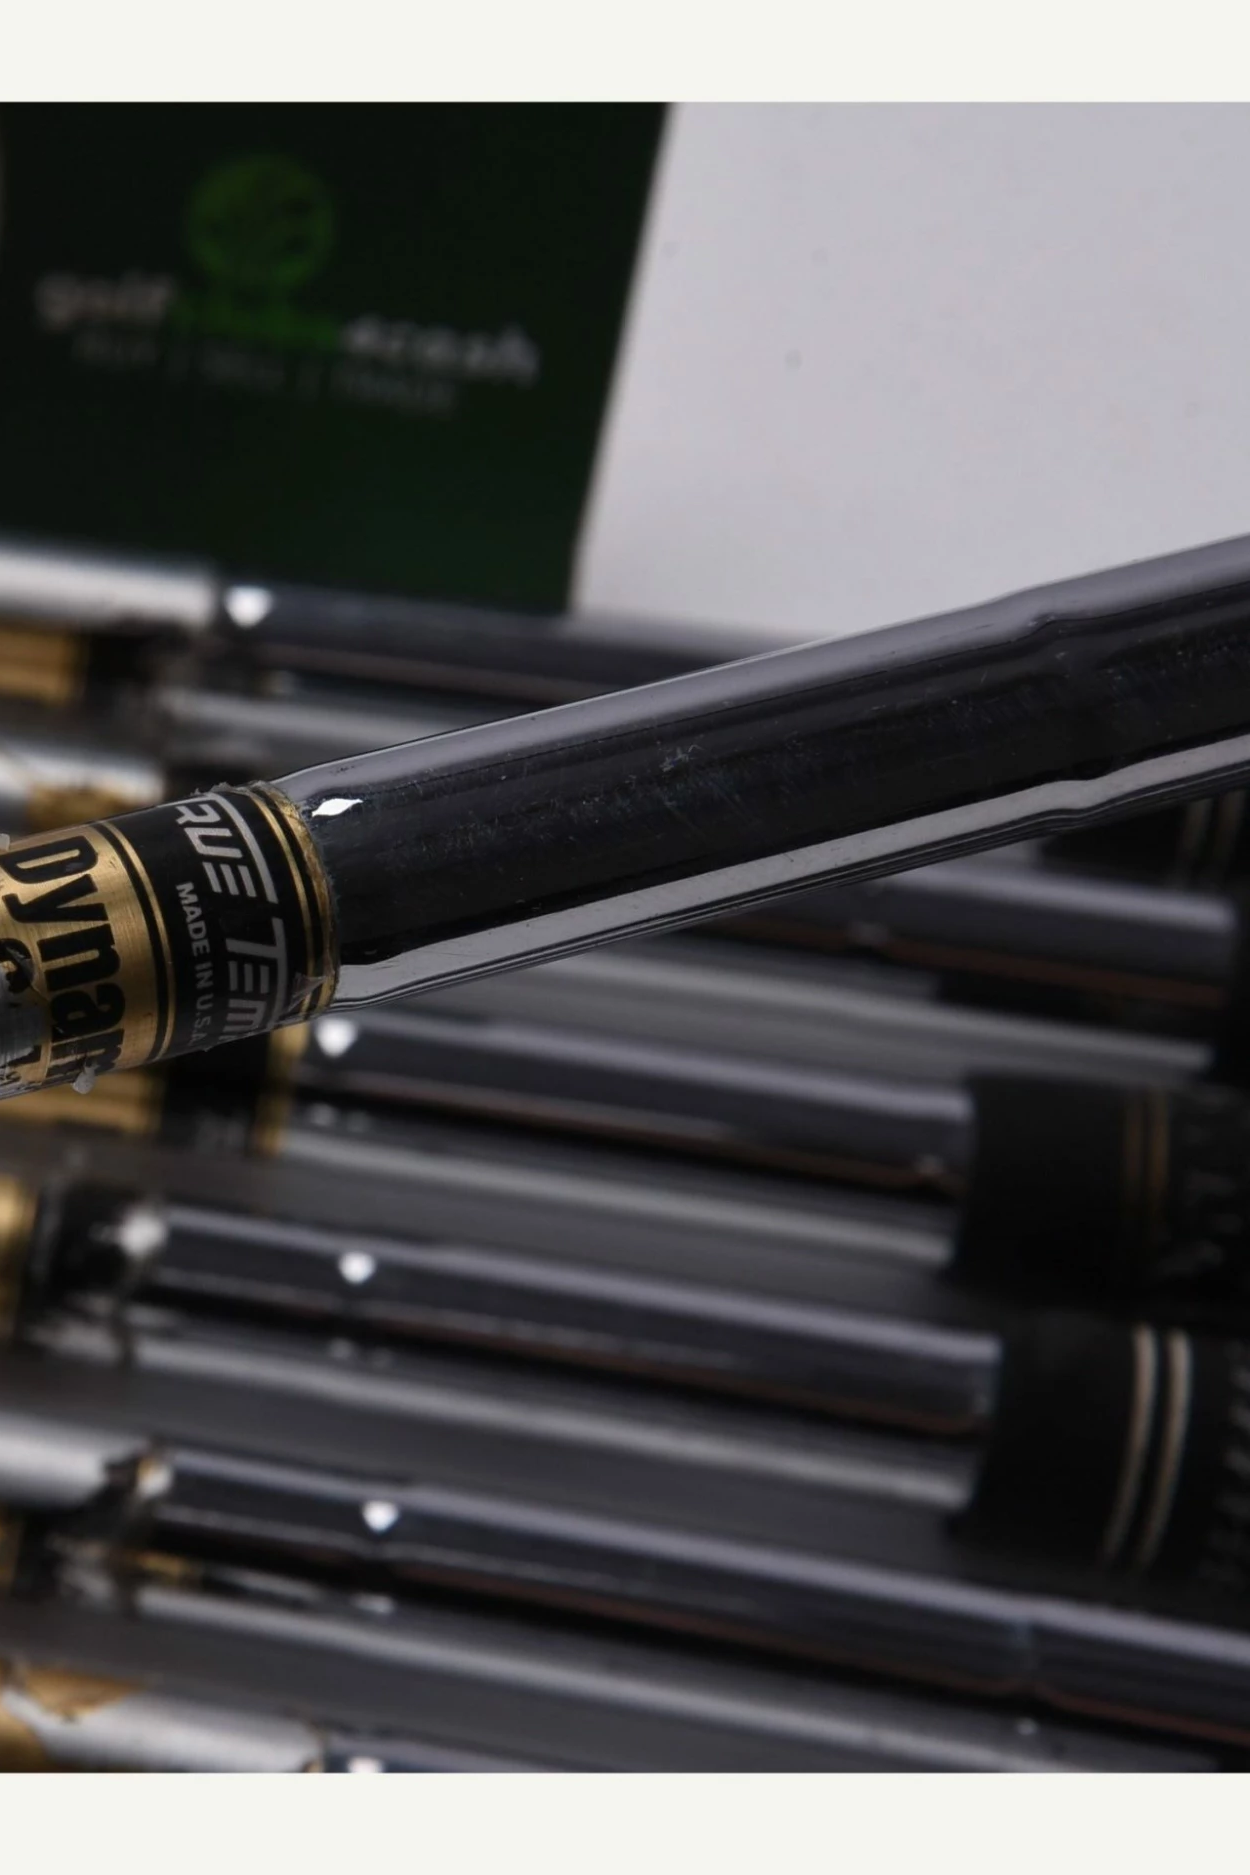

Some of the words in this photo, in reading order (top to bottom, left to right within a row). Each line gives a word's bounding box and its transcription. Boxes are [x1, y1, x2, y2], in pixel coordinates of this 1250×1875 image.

[176, 882, 211, 957] MADE
[194, 961, 214, 990] IN
[218, 917, 287, 1041] TEM
